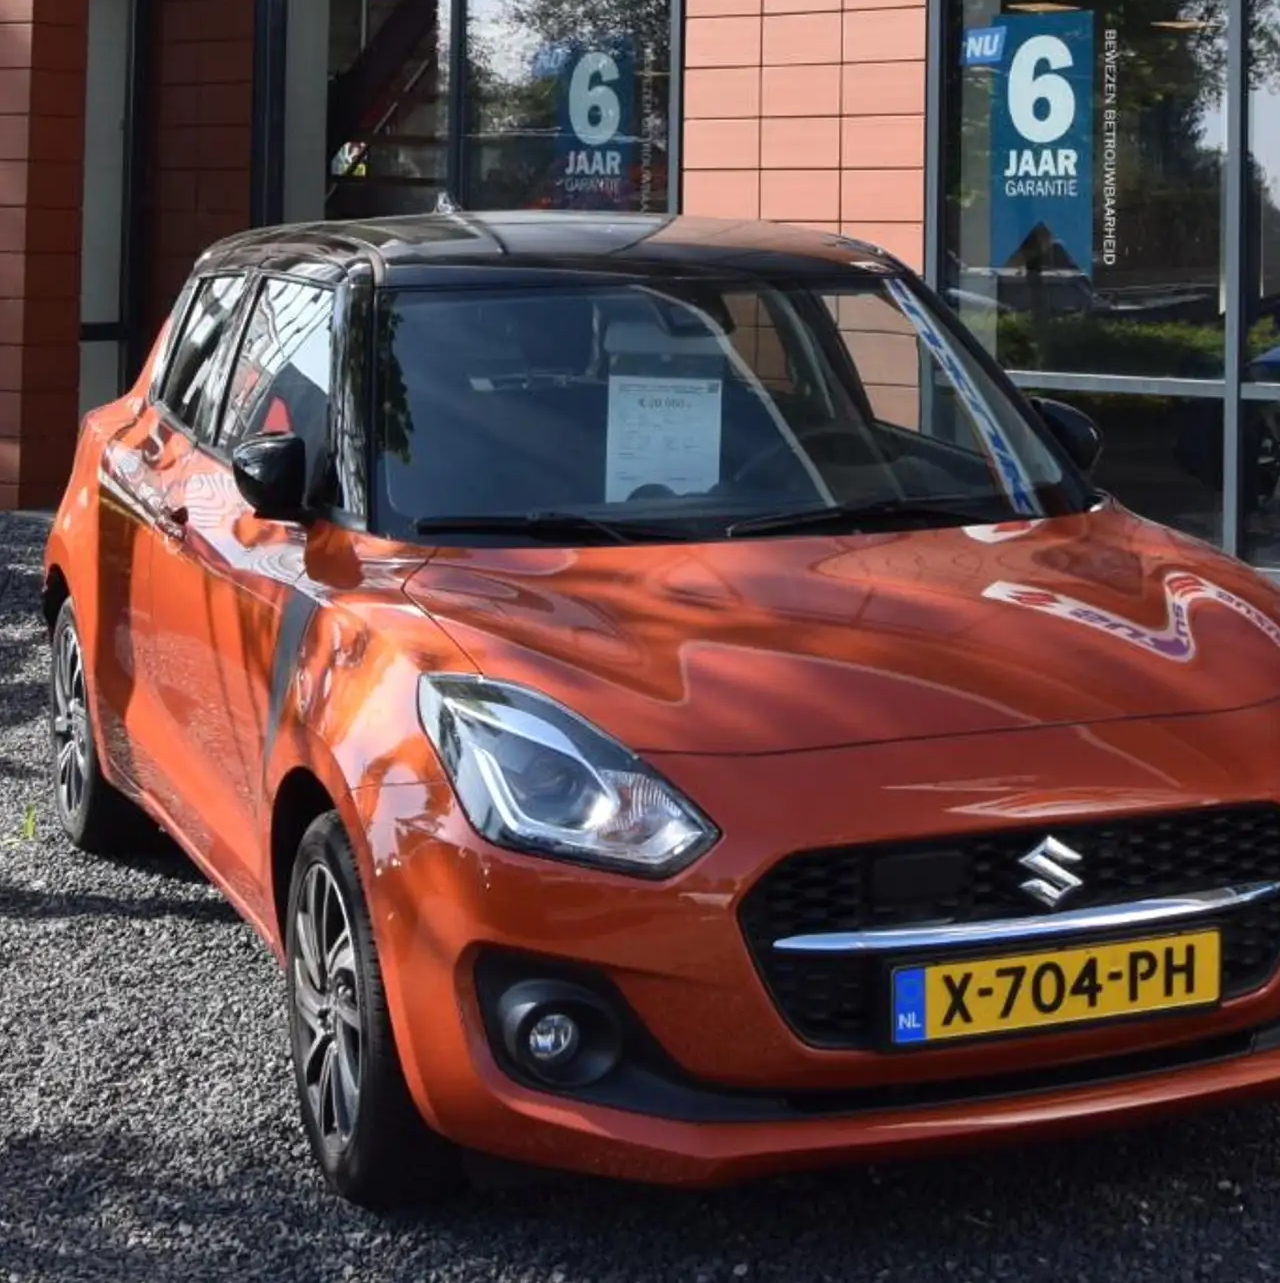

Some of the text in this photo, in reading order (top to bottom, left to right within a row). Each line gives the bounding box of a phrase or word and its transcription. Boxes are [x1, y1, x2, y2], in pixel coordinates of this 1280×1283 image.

[966, 34, 999, 58] NU
[568, 51, 620, 146] 6
[1008, 34, 1076, 144] 6
[1103, 29, 1117, 265] BEWEZEN BETROUWBAARHEID
[565, 151, 622, 175] JAAR
[1004, 149, 1078, 177] JAAR
[1005, 180, 1078, 197] GARANTIE
[941, 943, 1196, 1027] X-704-PH
[898, 1012, 922, 1029] NL
